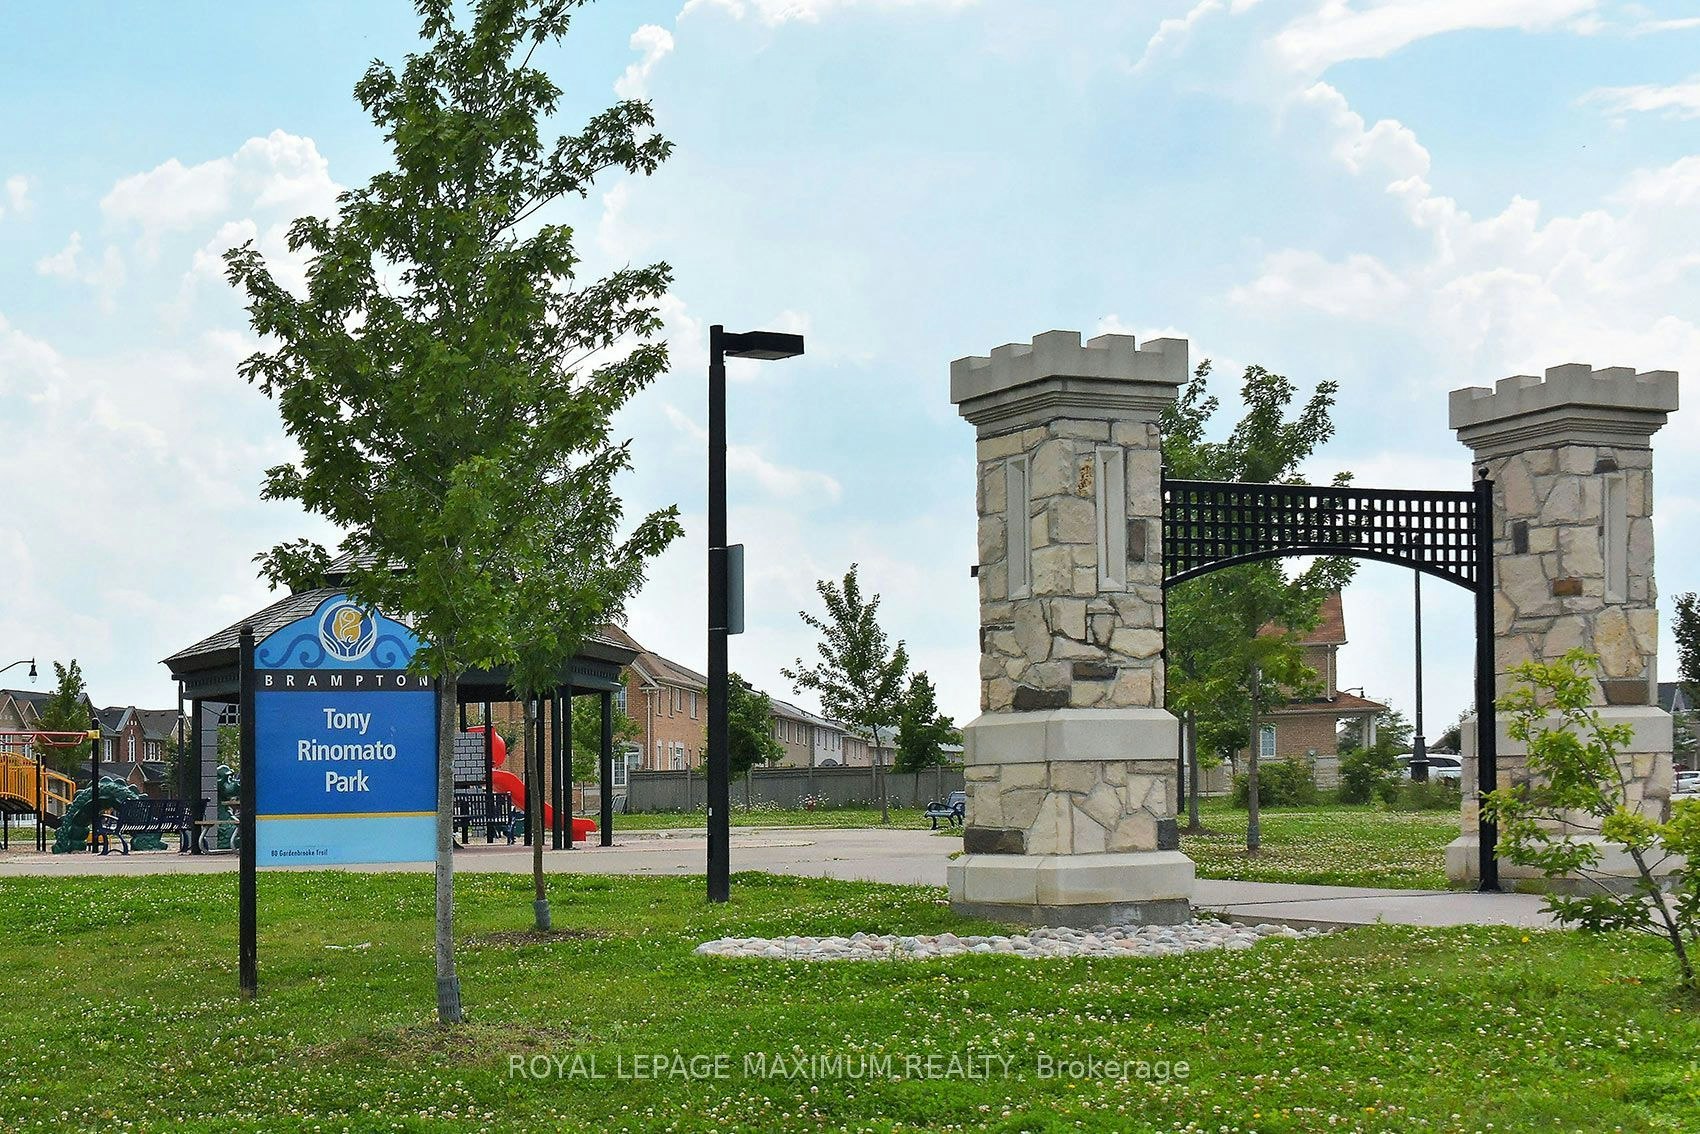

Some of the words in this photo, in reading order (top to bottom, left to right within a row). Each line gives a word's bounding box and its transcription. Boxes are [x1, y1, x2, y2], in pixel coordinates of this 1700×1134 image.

[264, 674, 428, 687] BRAMPTON
[323, 707, 371, 735] Tony
[298, 738, 396, 761] Rinomato
[325, 769, 370, 793] Park
